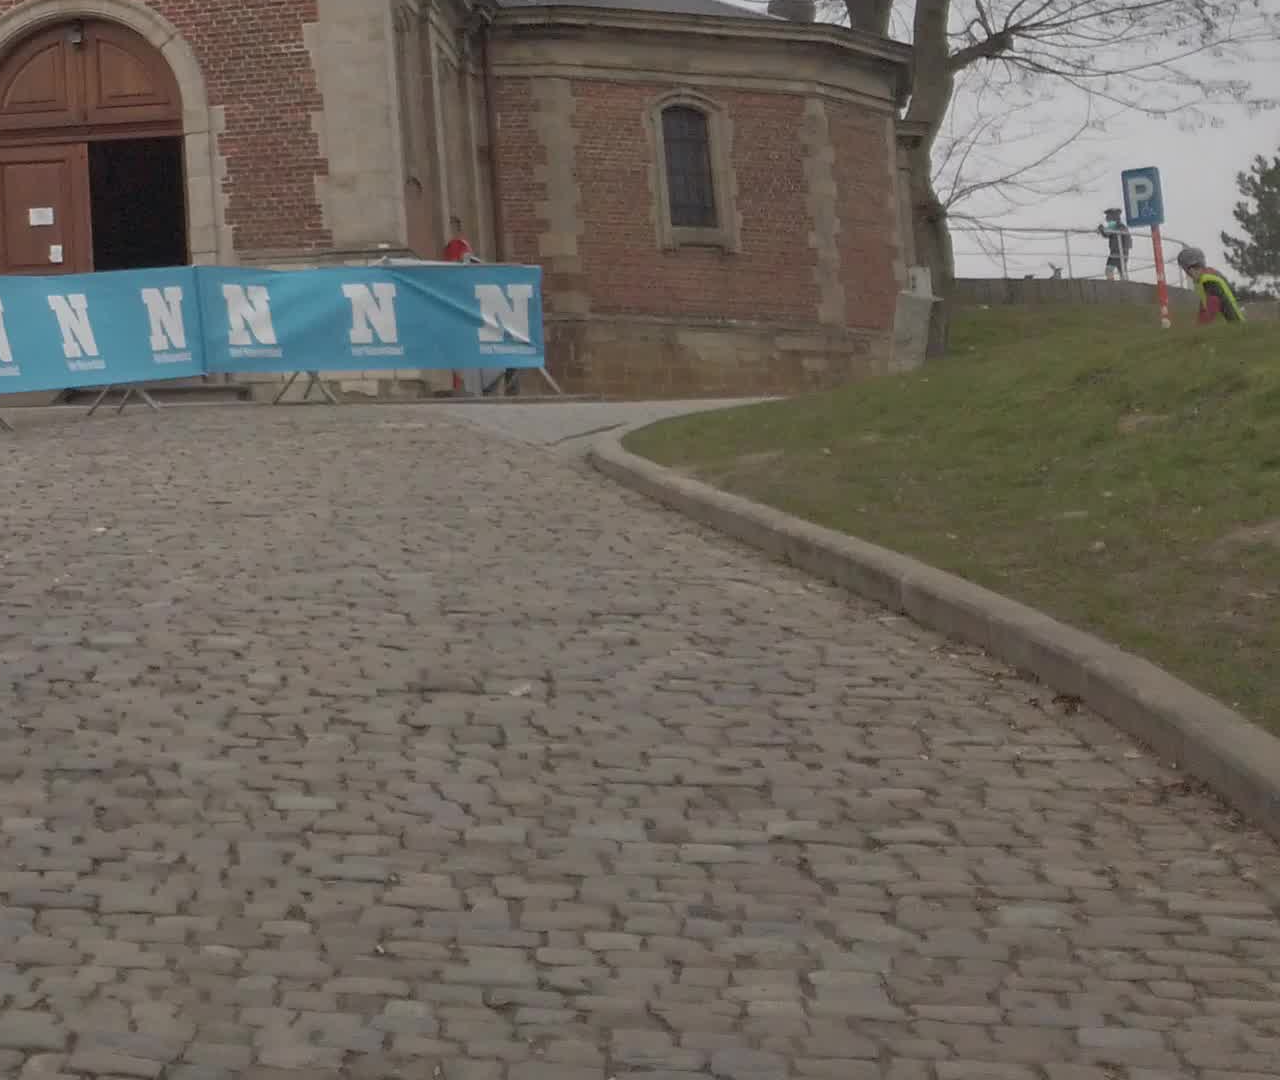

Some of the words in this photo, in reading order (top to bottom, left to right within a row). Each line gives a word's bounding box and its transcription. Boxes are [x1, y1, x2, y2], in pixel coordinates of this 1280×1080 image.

[1127, 177, 1154, 218] P
[48, 294, 98, 358] N
[141, 286, 187, 351] N
[223, 284, 276, 345] N
[341, 283, 397, 343] N
[475, 285, 532, 343] N
